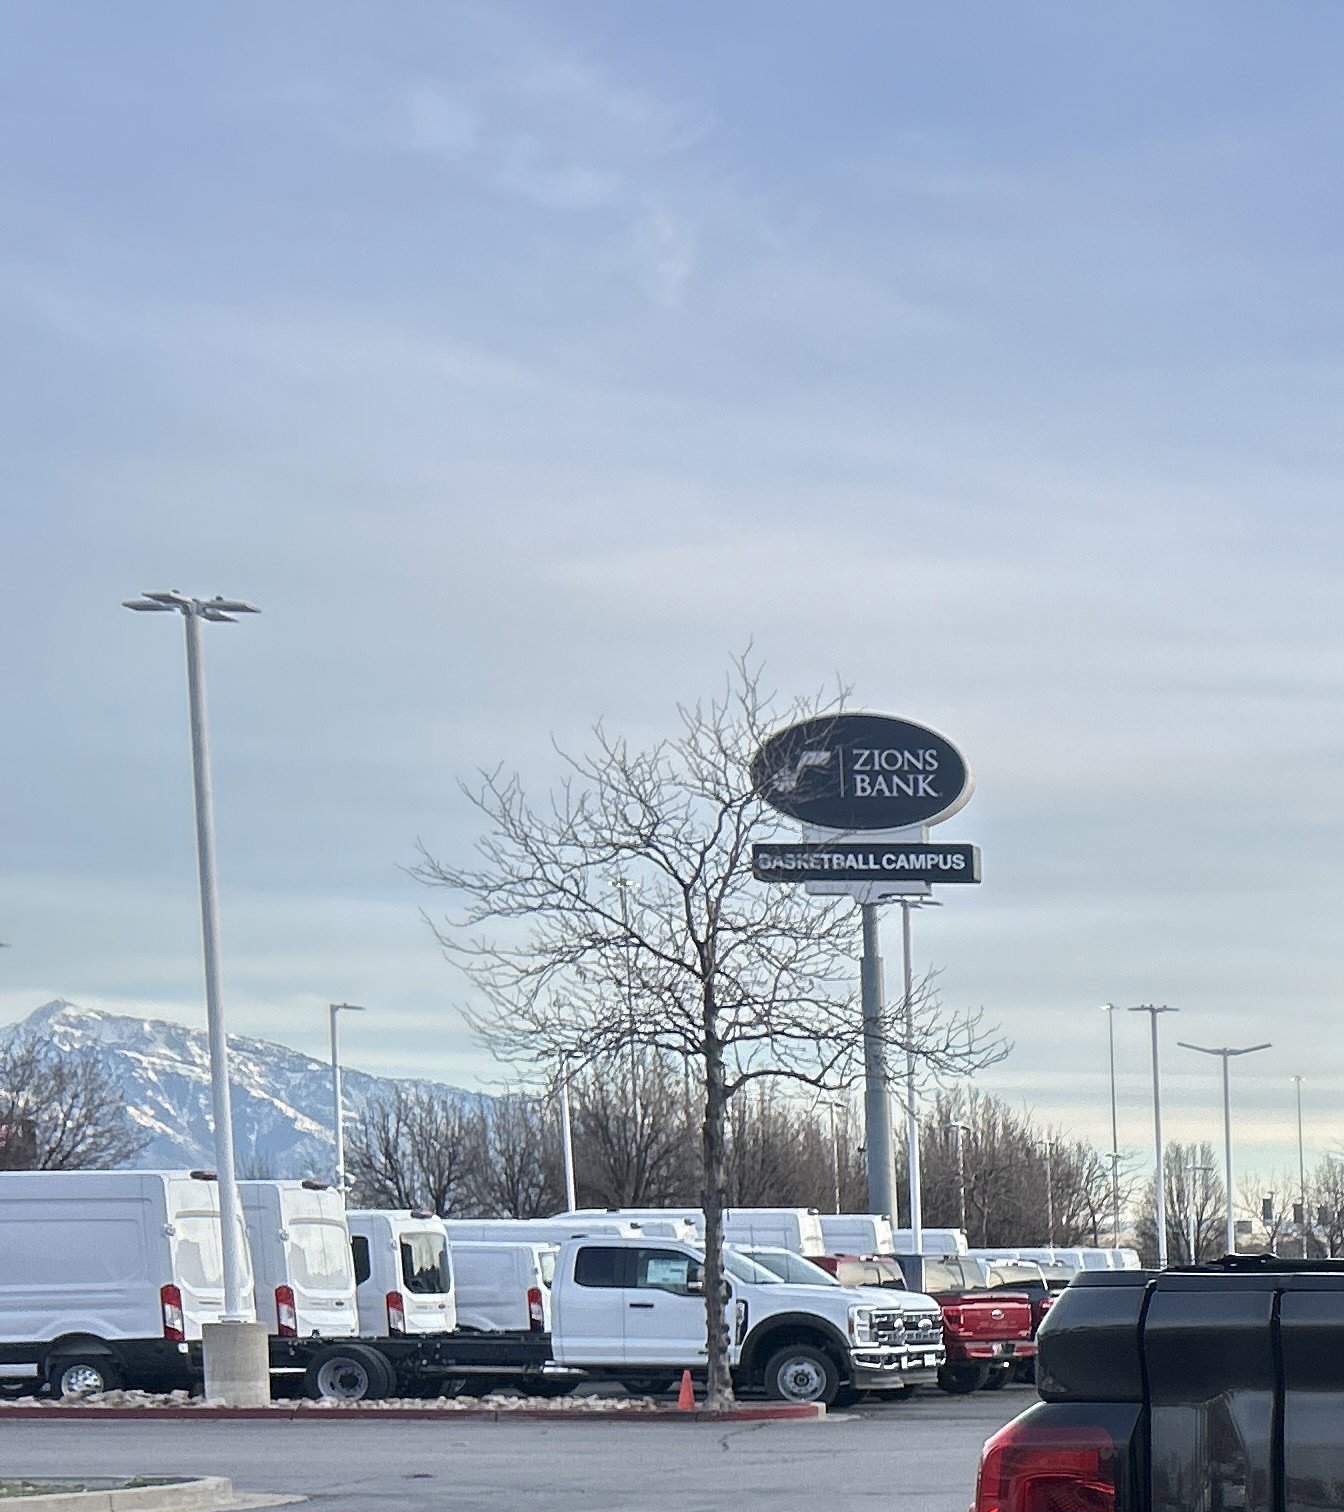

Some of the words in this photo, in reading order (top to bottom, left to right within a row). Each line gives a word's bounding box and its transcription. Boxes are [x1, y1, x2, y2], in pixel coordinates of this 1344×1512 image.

[852, 748, 938, 771] ZIONS
[853, 774, 939, 797] BANK
[758, 853, 880, 870] BASKETBALL
[881, 853, 966, 870] CAMPUS
